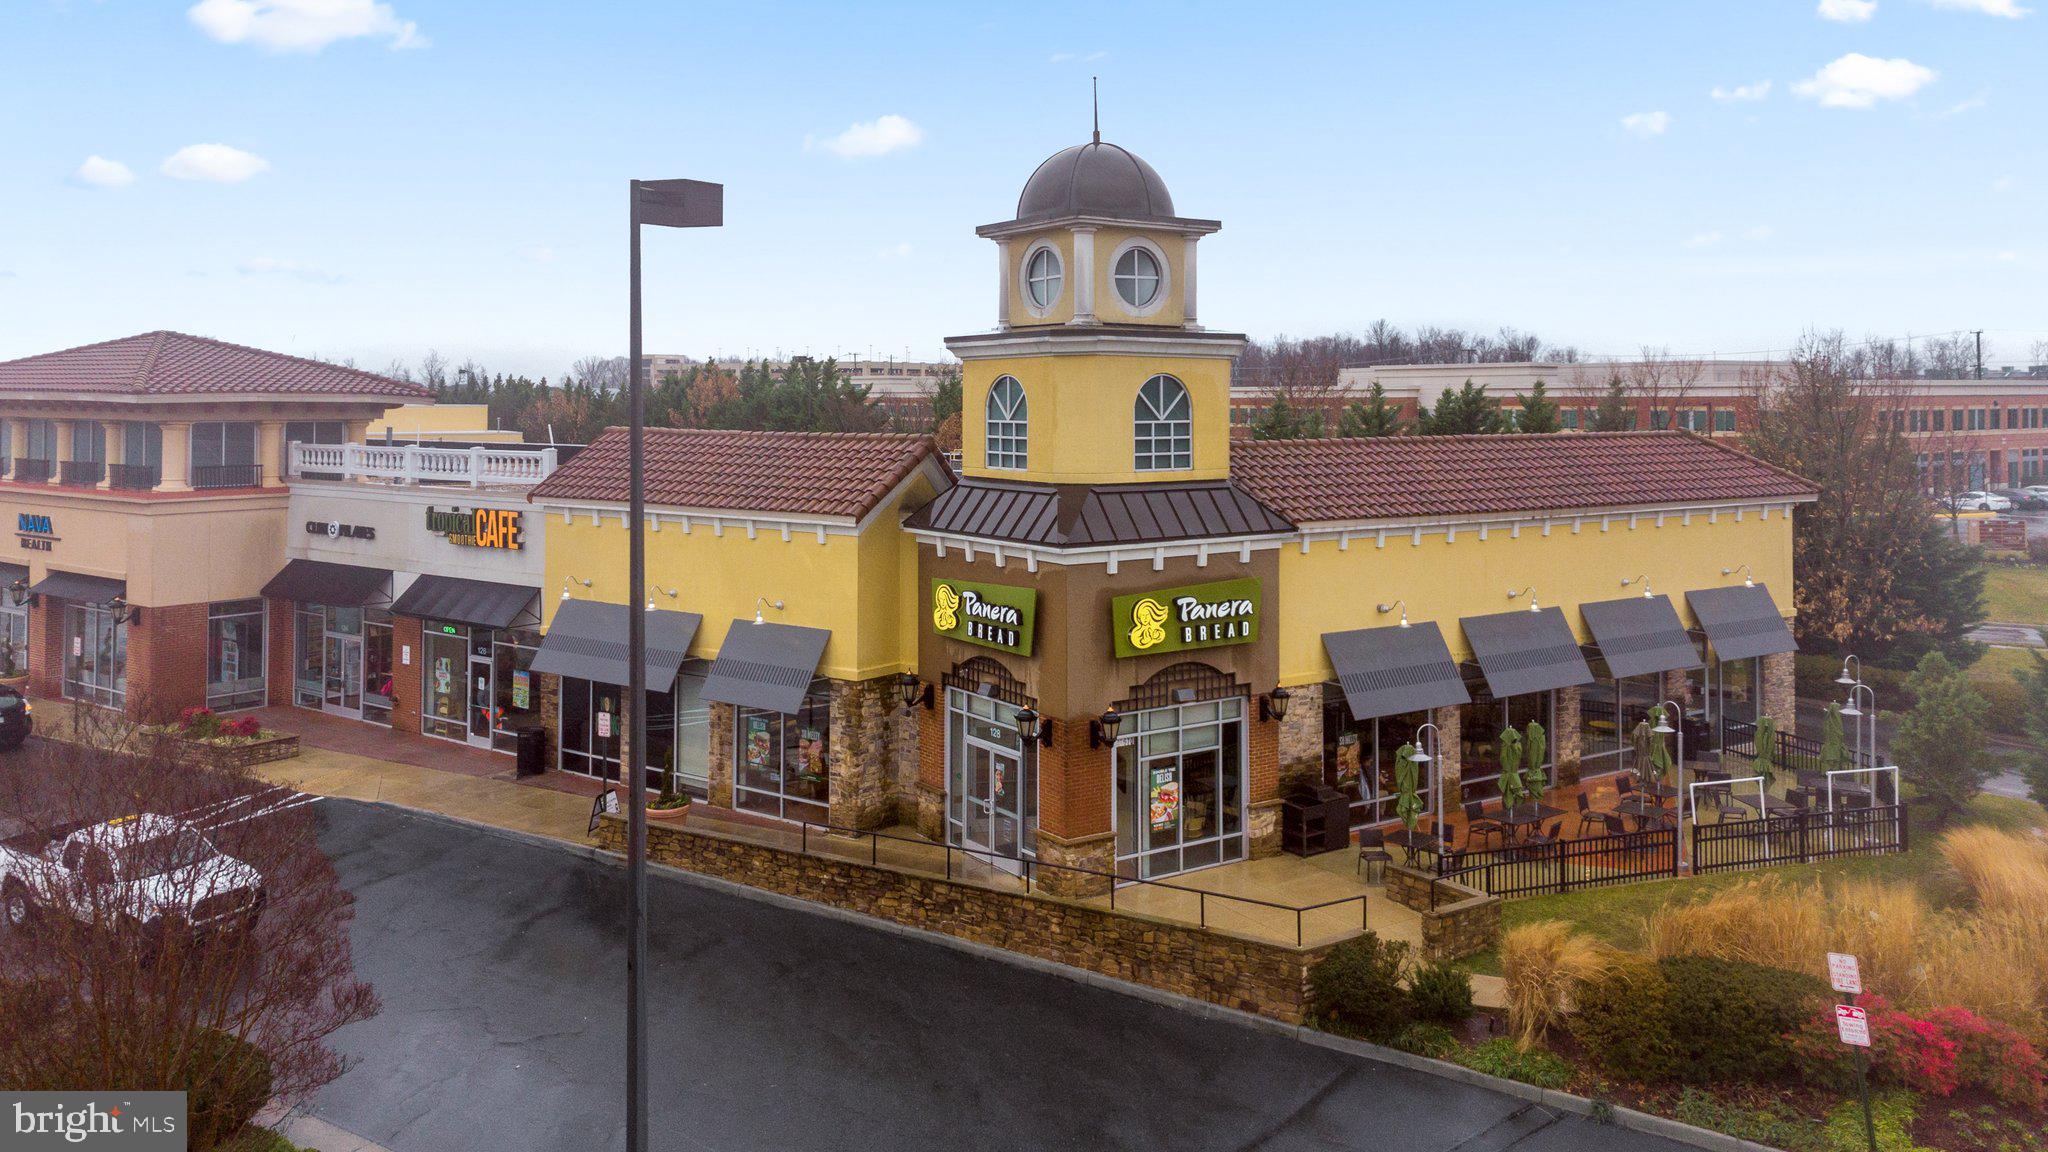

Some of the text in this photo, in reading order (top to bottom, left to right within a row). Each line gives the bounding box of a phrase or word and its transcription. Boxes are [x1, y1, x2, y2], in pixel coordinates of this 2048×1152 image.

[18, 513, 53, 534] NAVA
[476, 508, 519, 550] CAFE
[448, 533, 477, 546] SMOOTHIE
[962, 591, 1018, 625] Panera
[1177, 597, 1253, 622] Panera
[967, 621, 1014, 646] BREAD
[1185, 622, 1249, 643] BREAD
[990, 727, 1001, 738] 128
